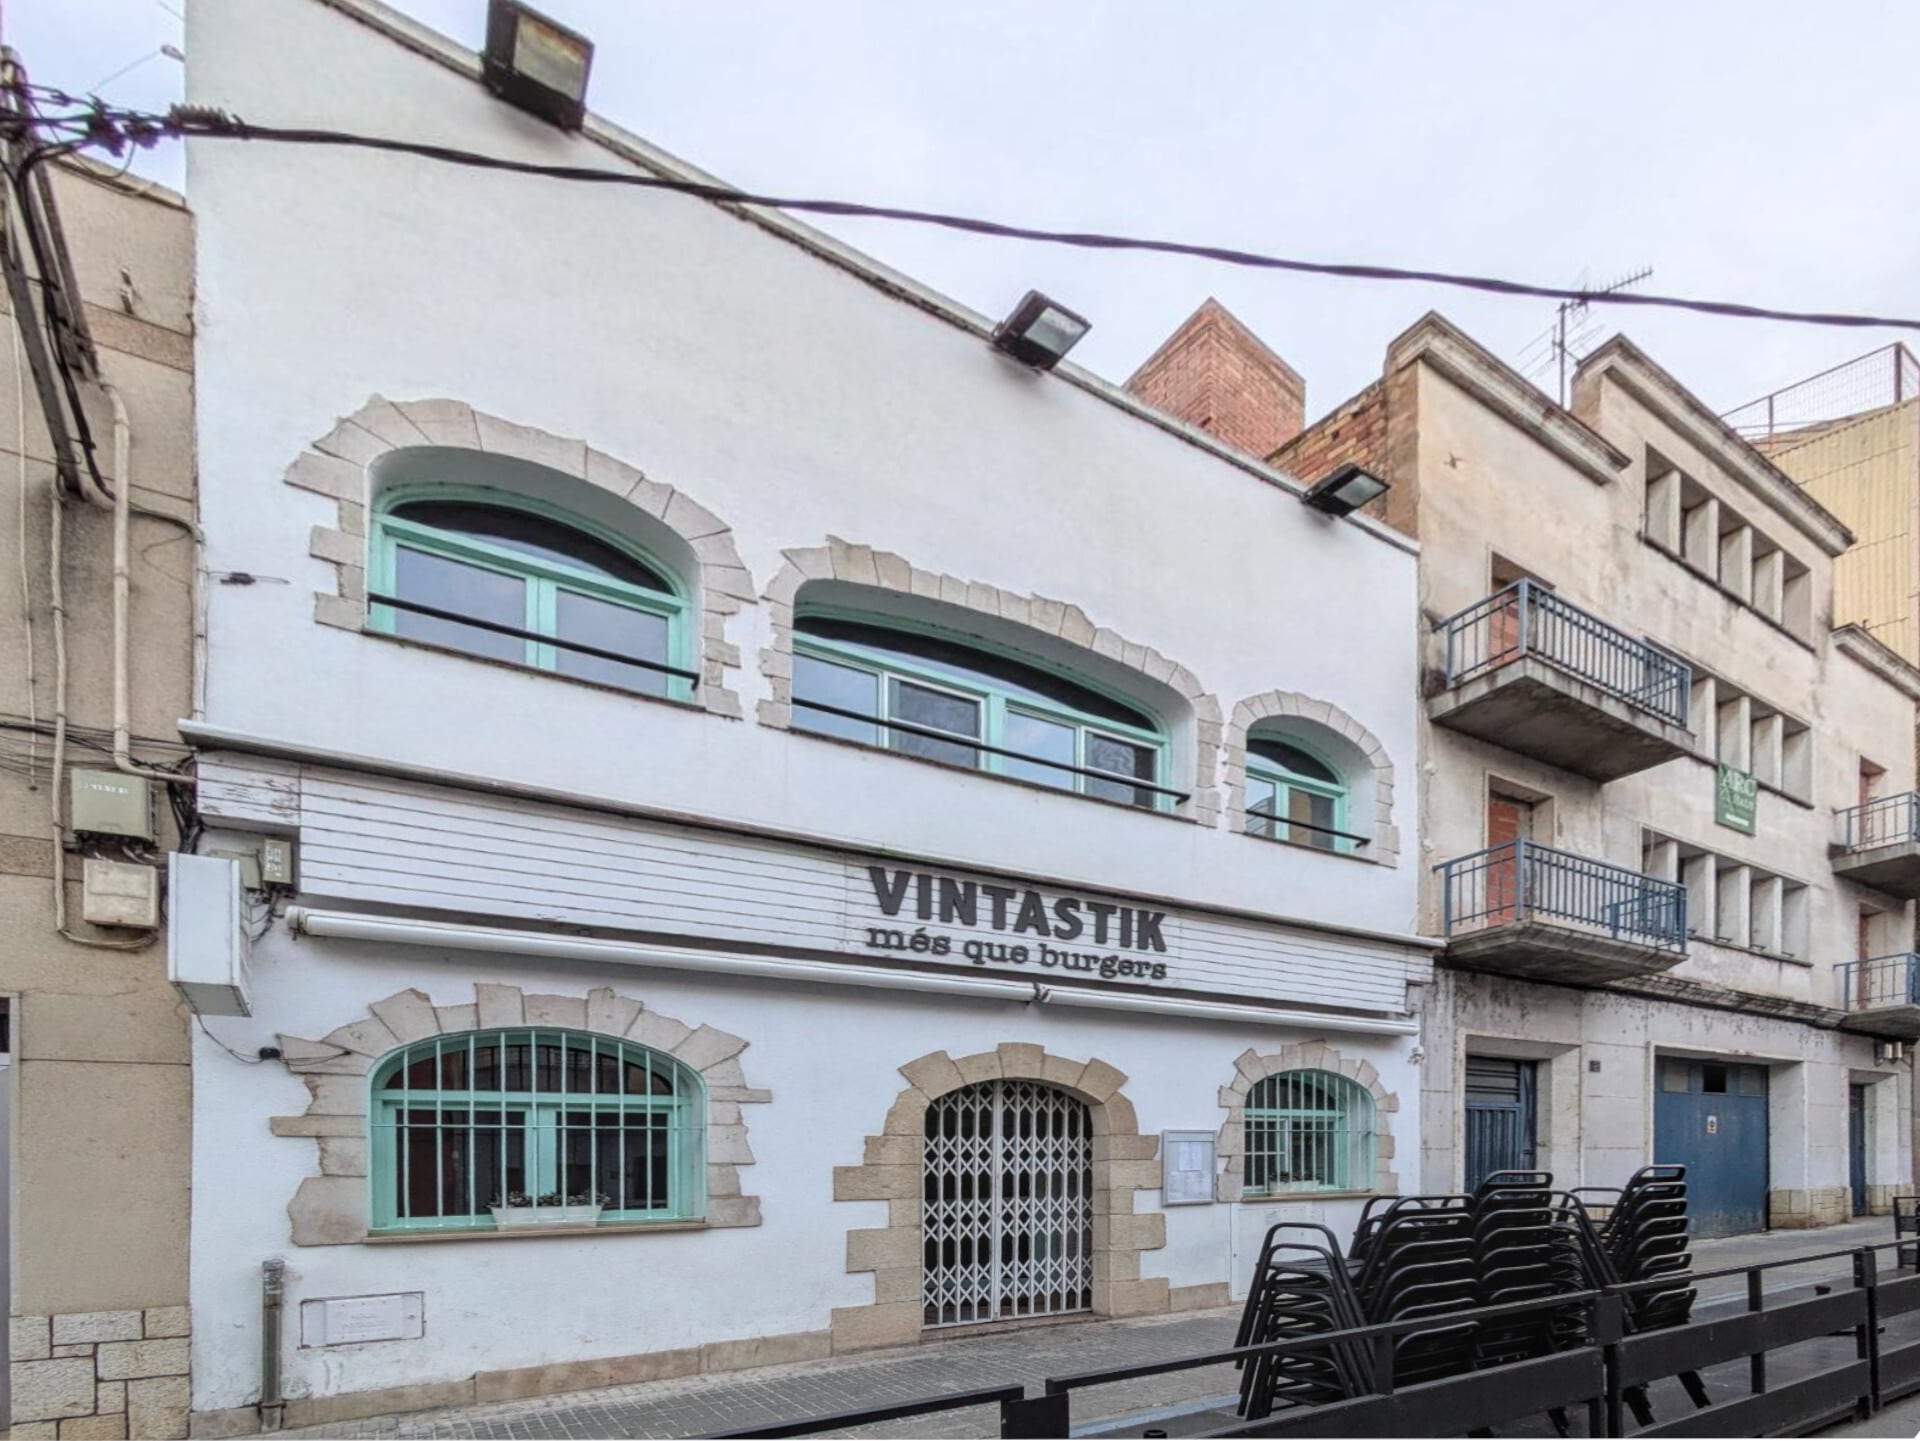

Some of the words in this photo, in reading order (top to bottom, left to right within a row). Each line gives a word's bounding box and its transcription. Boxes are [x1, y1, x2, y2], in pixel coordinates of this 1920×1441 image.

[869, 866, 1167, 953] VINTASTIK
[865, 926, 951, 956] més
[963, 938, 1029, 965] que
[1038, 943, 1167, 980] burgers
